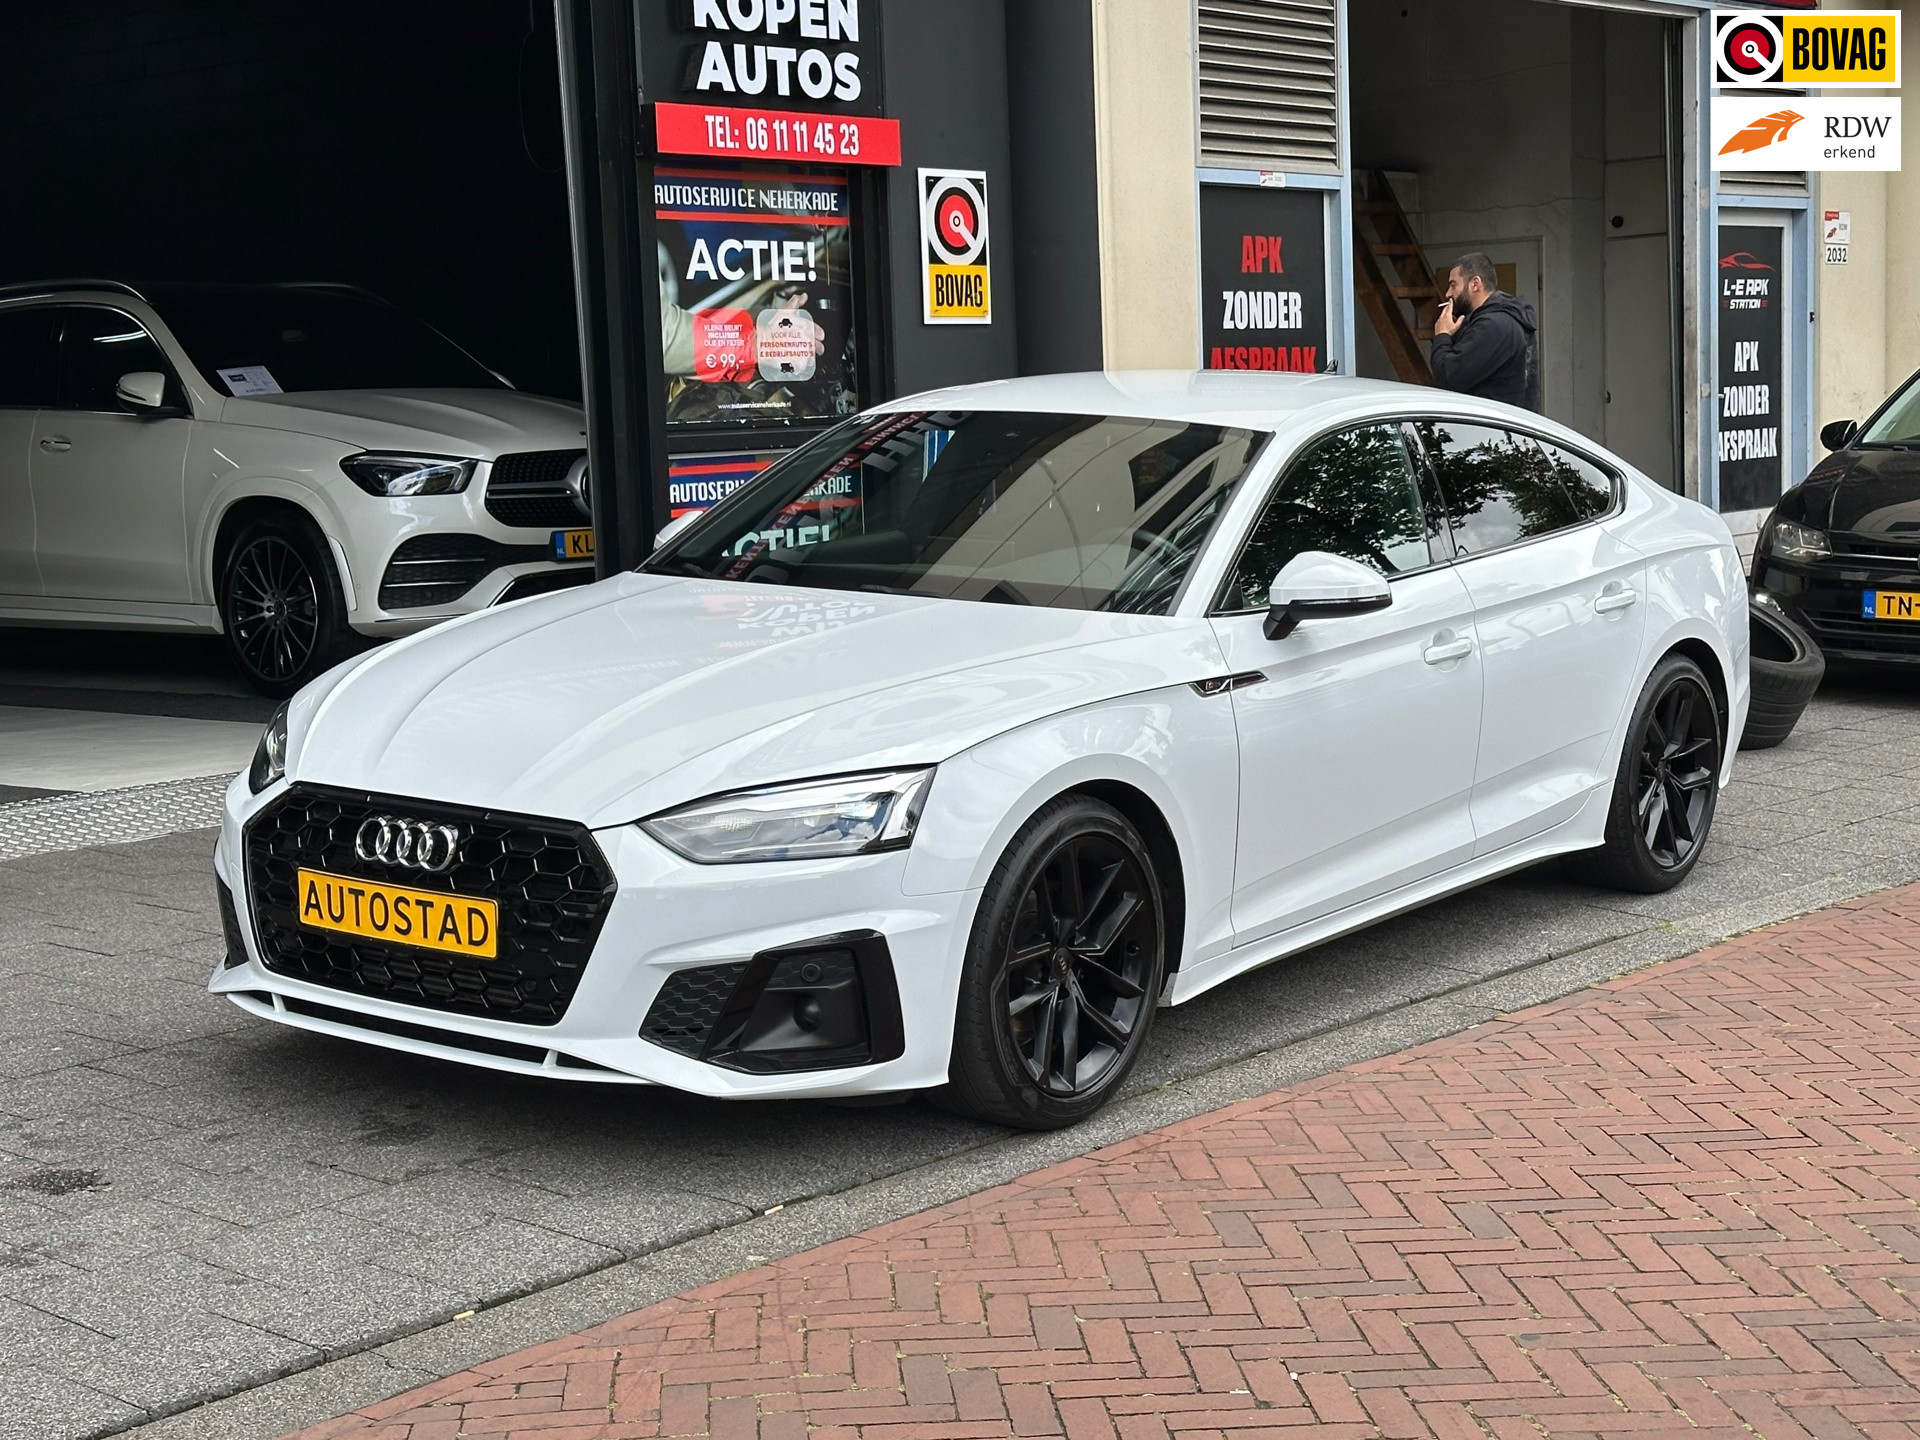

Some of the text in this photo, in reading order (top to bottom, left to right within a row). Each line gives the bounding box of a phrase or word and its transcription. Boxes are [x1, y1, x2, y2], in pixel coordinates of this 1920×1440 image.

[693, 0, 859, 42] KOPEN
[696, 41, 861, 101] AUTOS
[704, 115, 860, 156] TEL: 06 11 11 45 23
[654, 184, 839, 211] AUTOSERVICE NEHERKADE
[686, 238, 817, 282] ACTIE!
[1241, 235, 1283, 273] APK
[1827, 247, 1847, 262] 2032
[935, 273, 983, 307] BOVAG
[1723, 279, 1769, 296] L-E APK
[1730, 299, 1761, 309] STATION
[1222, 291, 1303, 330] ZONDER
[705, 353, 745, 370] € 99,-
[1734, 341, 1759, 372] APK
[1723, 384, 1769, 417] ZONDER
[1719, 427, 1777, 462] AFSPRAAK
[1864, 606, 1874, 614] NL
[304, 879, 489, 946] AUTOSTAD
